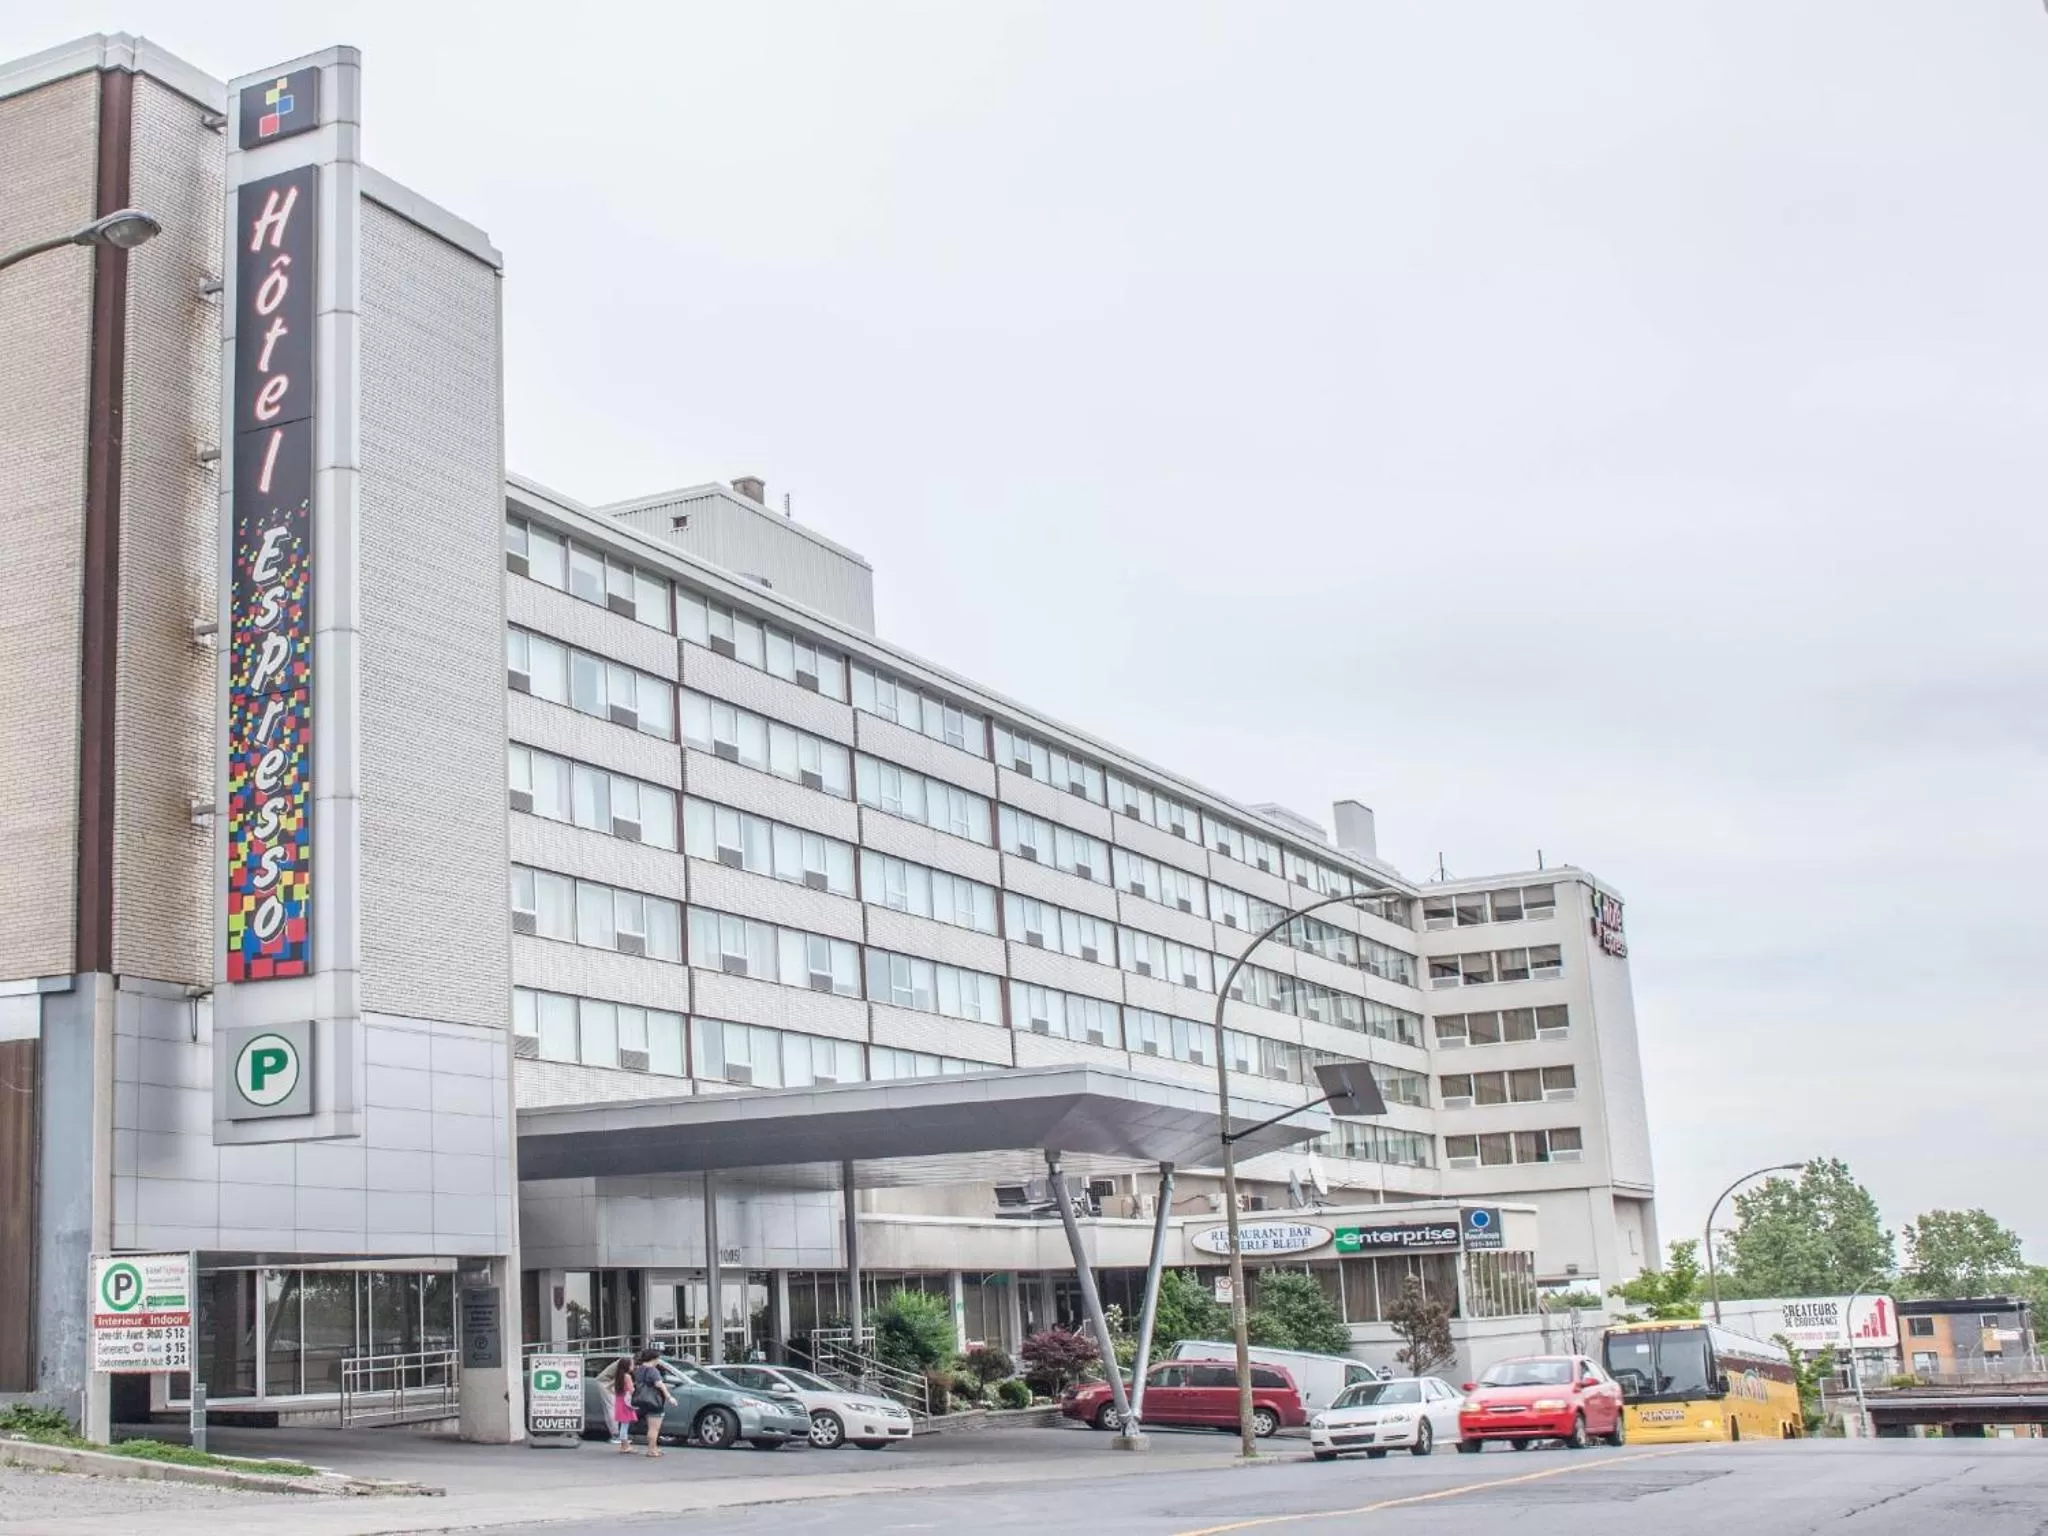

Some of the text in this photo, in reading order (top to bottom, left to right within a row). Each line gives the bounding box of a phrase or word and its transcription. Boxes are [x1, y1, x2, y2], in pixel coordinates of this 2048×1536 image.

[250, 186, 299, 495] Hôtel
[251, 526, 293, 944] Espresso
[250, 1048, 289, 1091] P
[1211, 1226, 1312, 1241] REAURANT BAR
[1337, 1226, 1456, 1245] enterprise
[1273, 1237, 1309, 1249] BLEUE
[114, 1273, 132, 1301] P
[150, 1314, 183, 1325] Indoor
[175, 1342, 186, 1353] 15
[174, 1355, 185, 1365] 24
[541, 1374, 558, 1388] P
[536, 1418, 578, 1429] OUVERT
